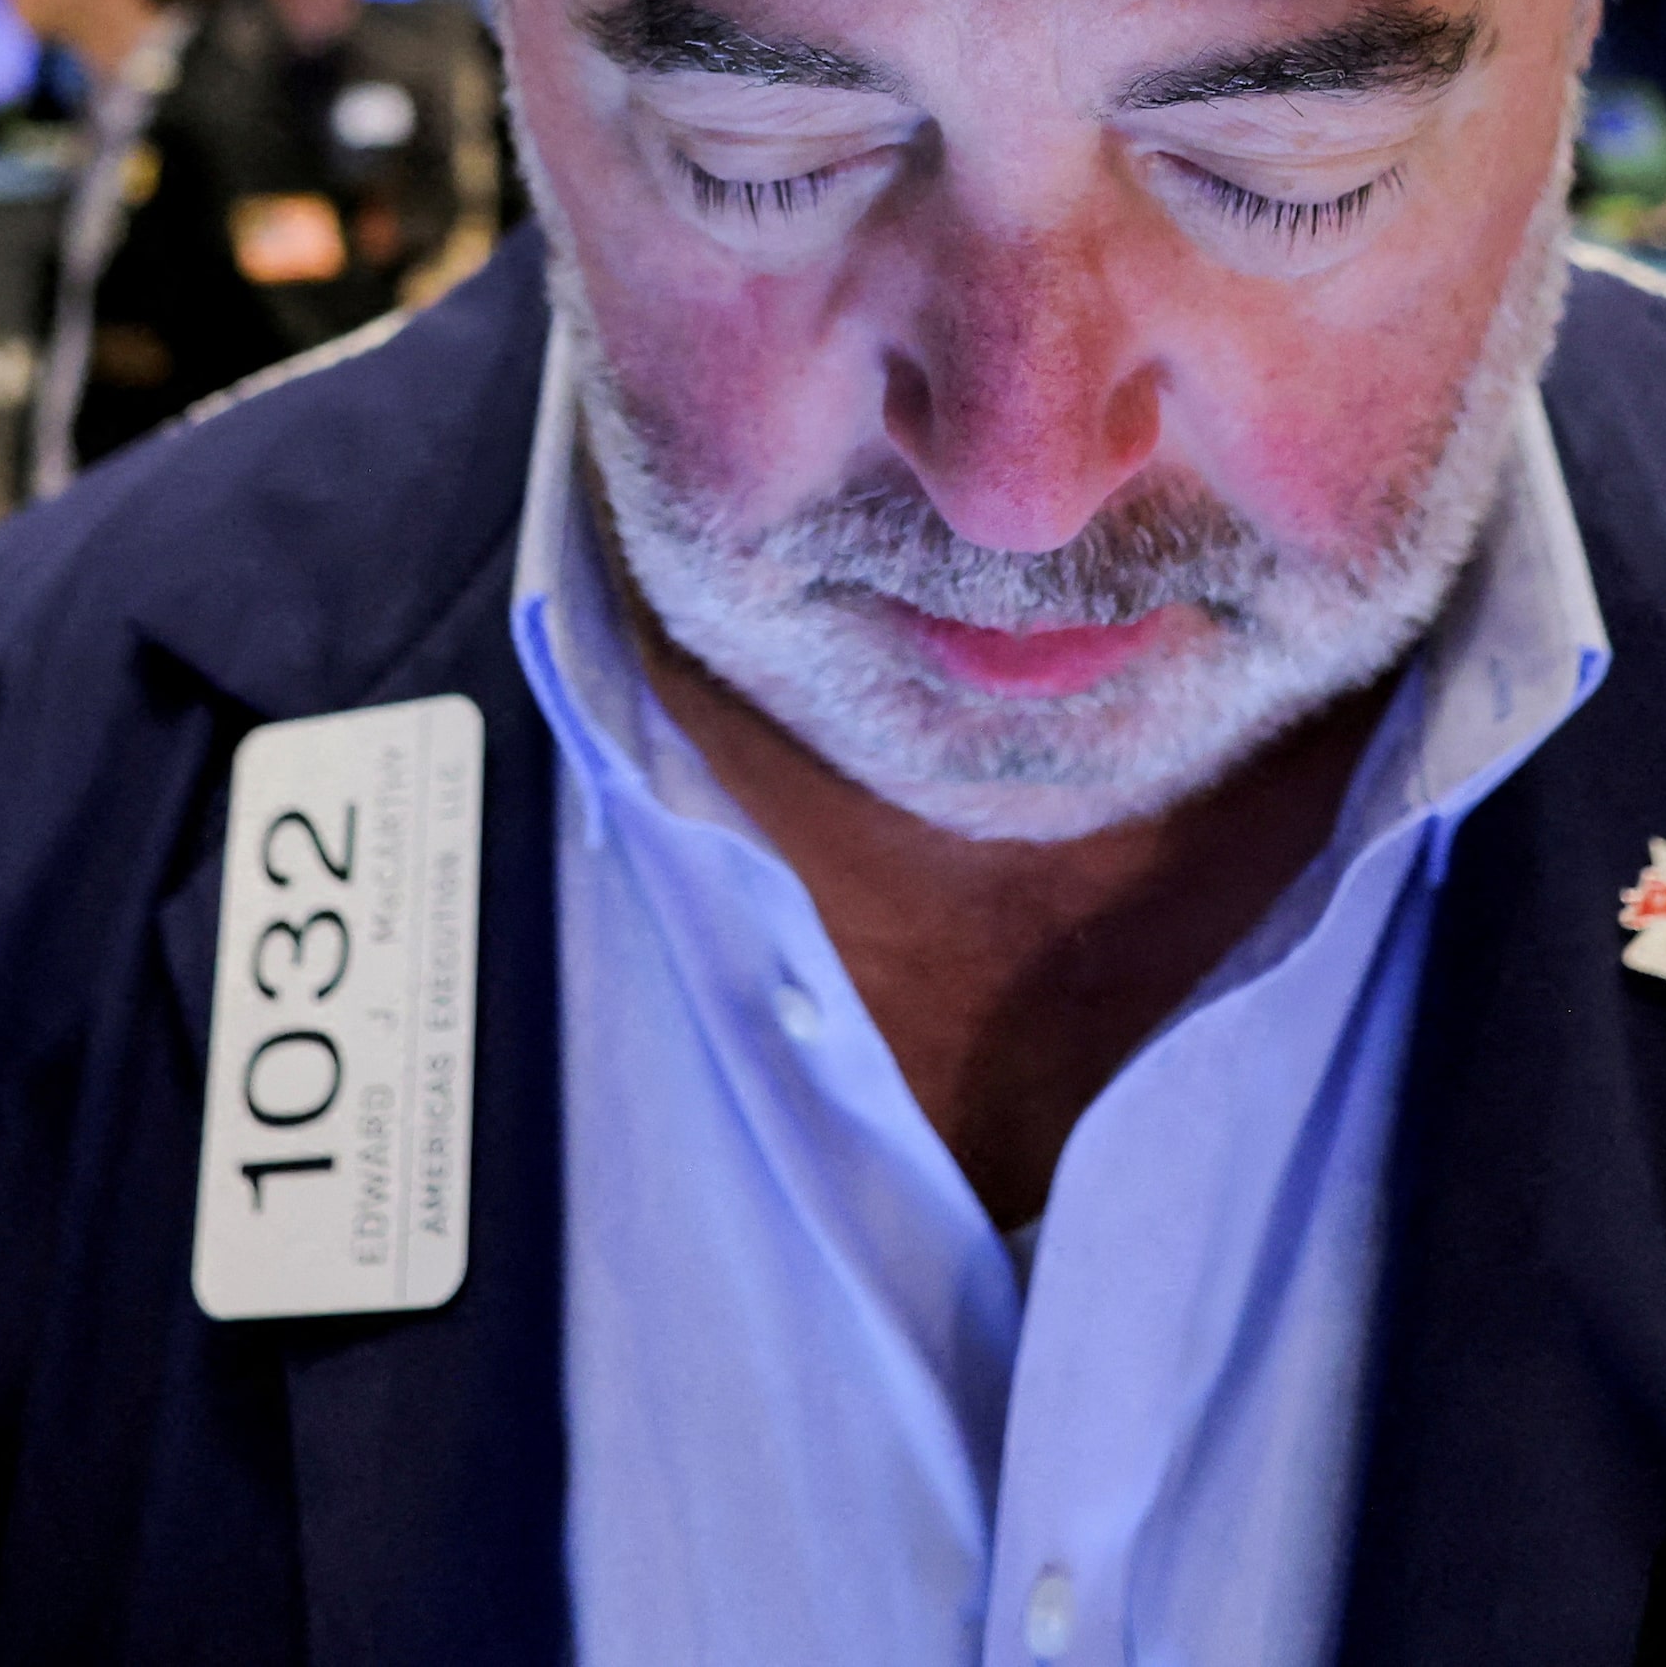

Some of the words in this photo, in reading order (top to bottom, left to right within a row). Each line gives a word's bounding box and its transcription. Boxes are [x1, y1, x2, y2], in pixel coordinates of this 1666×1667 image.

[240, 799, 357, 1214] 1032
[350, 1084, 395, 1267] EDWARD
[419, 1051, 457, 1238] AMERICAS
